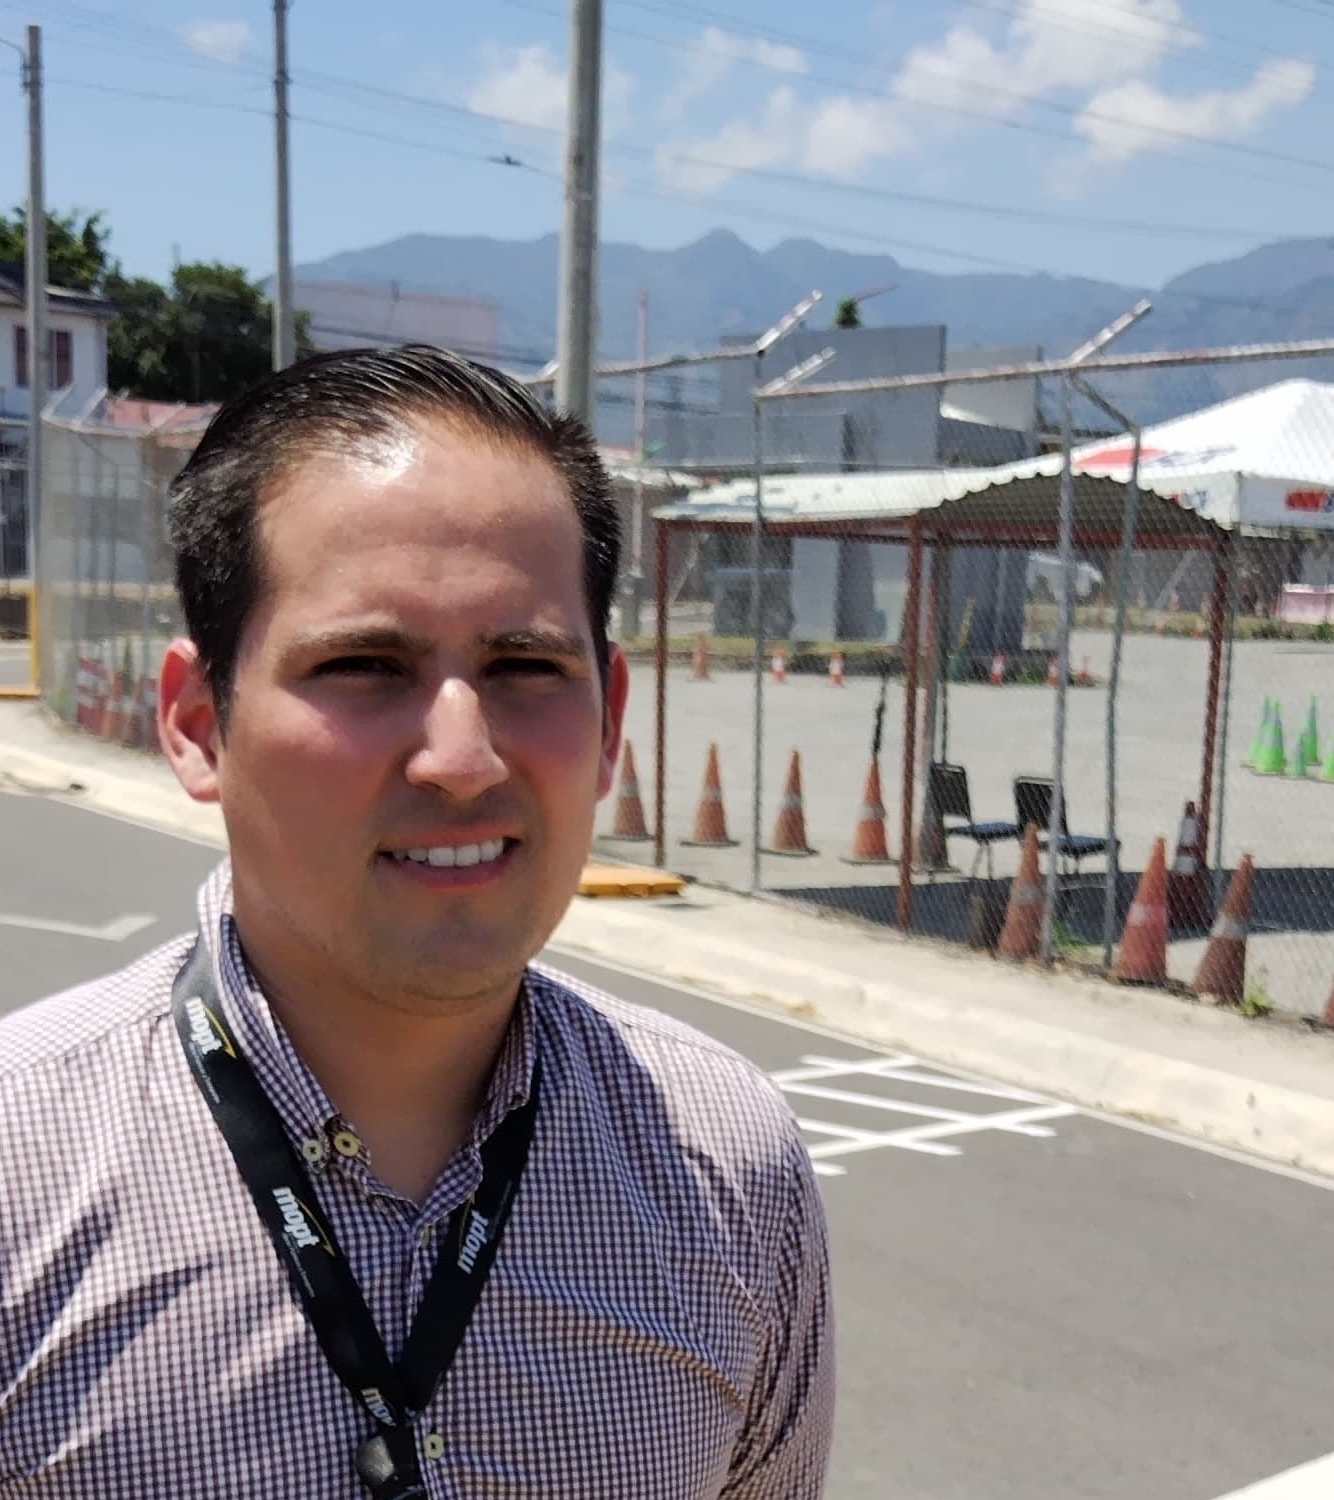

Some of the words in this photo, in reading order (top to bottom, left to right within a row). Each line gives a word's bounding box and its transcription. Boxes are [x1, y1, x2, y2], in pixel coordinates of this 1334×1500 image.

[185, 997, 223, 1055] mopt
[272, 1187, 320, 1248] mopt
[456, 1209, 489, 1275] mopt
